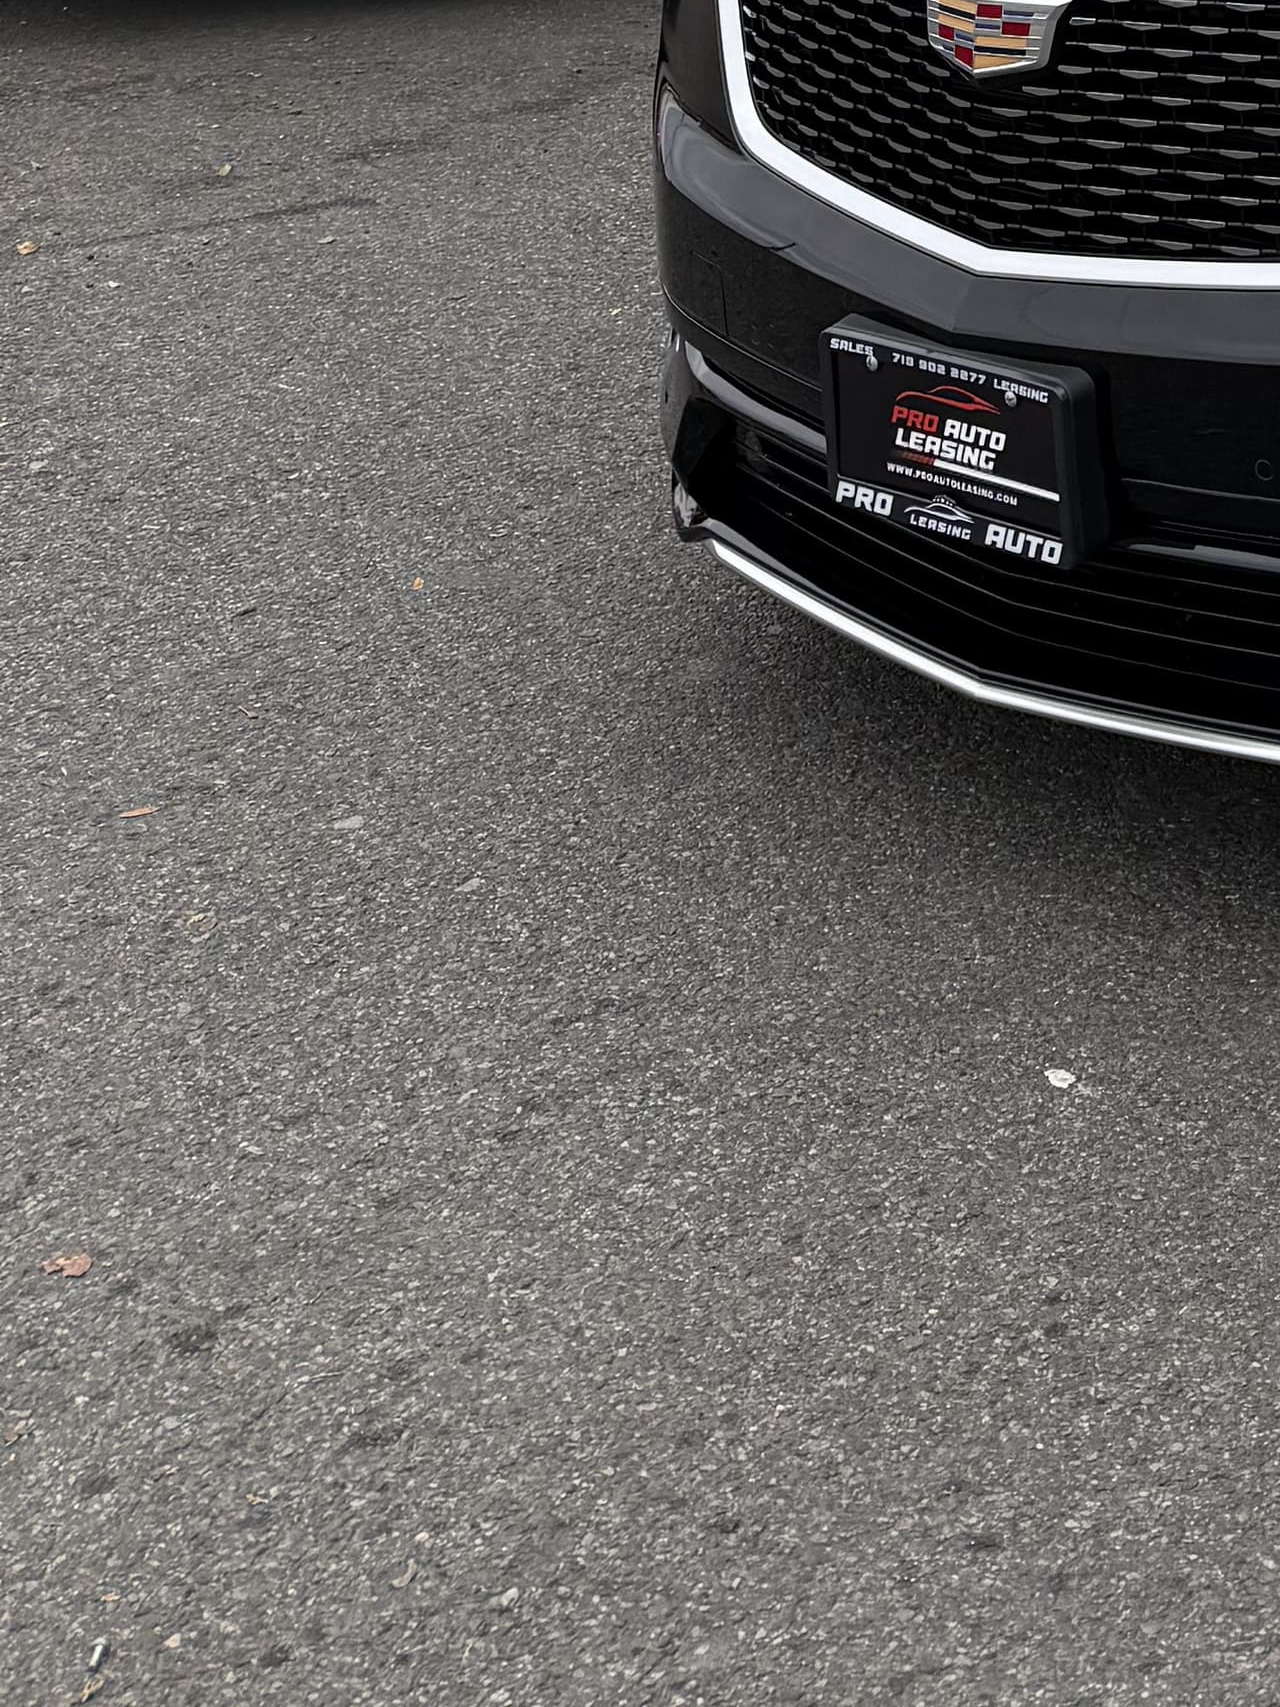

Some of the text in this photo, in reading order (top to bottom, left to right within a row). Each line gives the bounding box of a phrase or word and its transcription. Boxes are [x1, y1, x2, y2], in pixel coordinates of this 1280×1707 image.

[830, 338, 874, 356] SALES
[892, 352, 987, 386] 718 902 2277
[993, 378, 1049, 404] LEASING
[891, 404, 1007, 452] PRO AUTO
[895, 427, 996, 471] LEASING
[835, 480, 894, 516] PRO
[910, 513, 972, 540] LEASING
[984, 522, 1063, 566] AUTO
